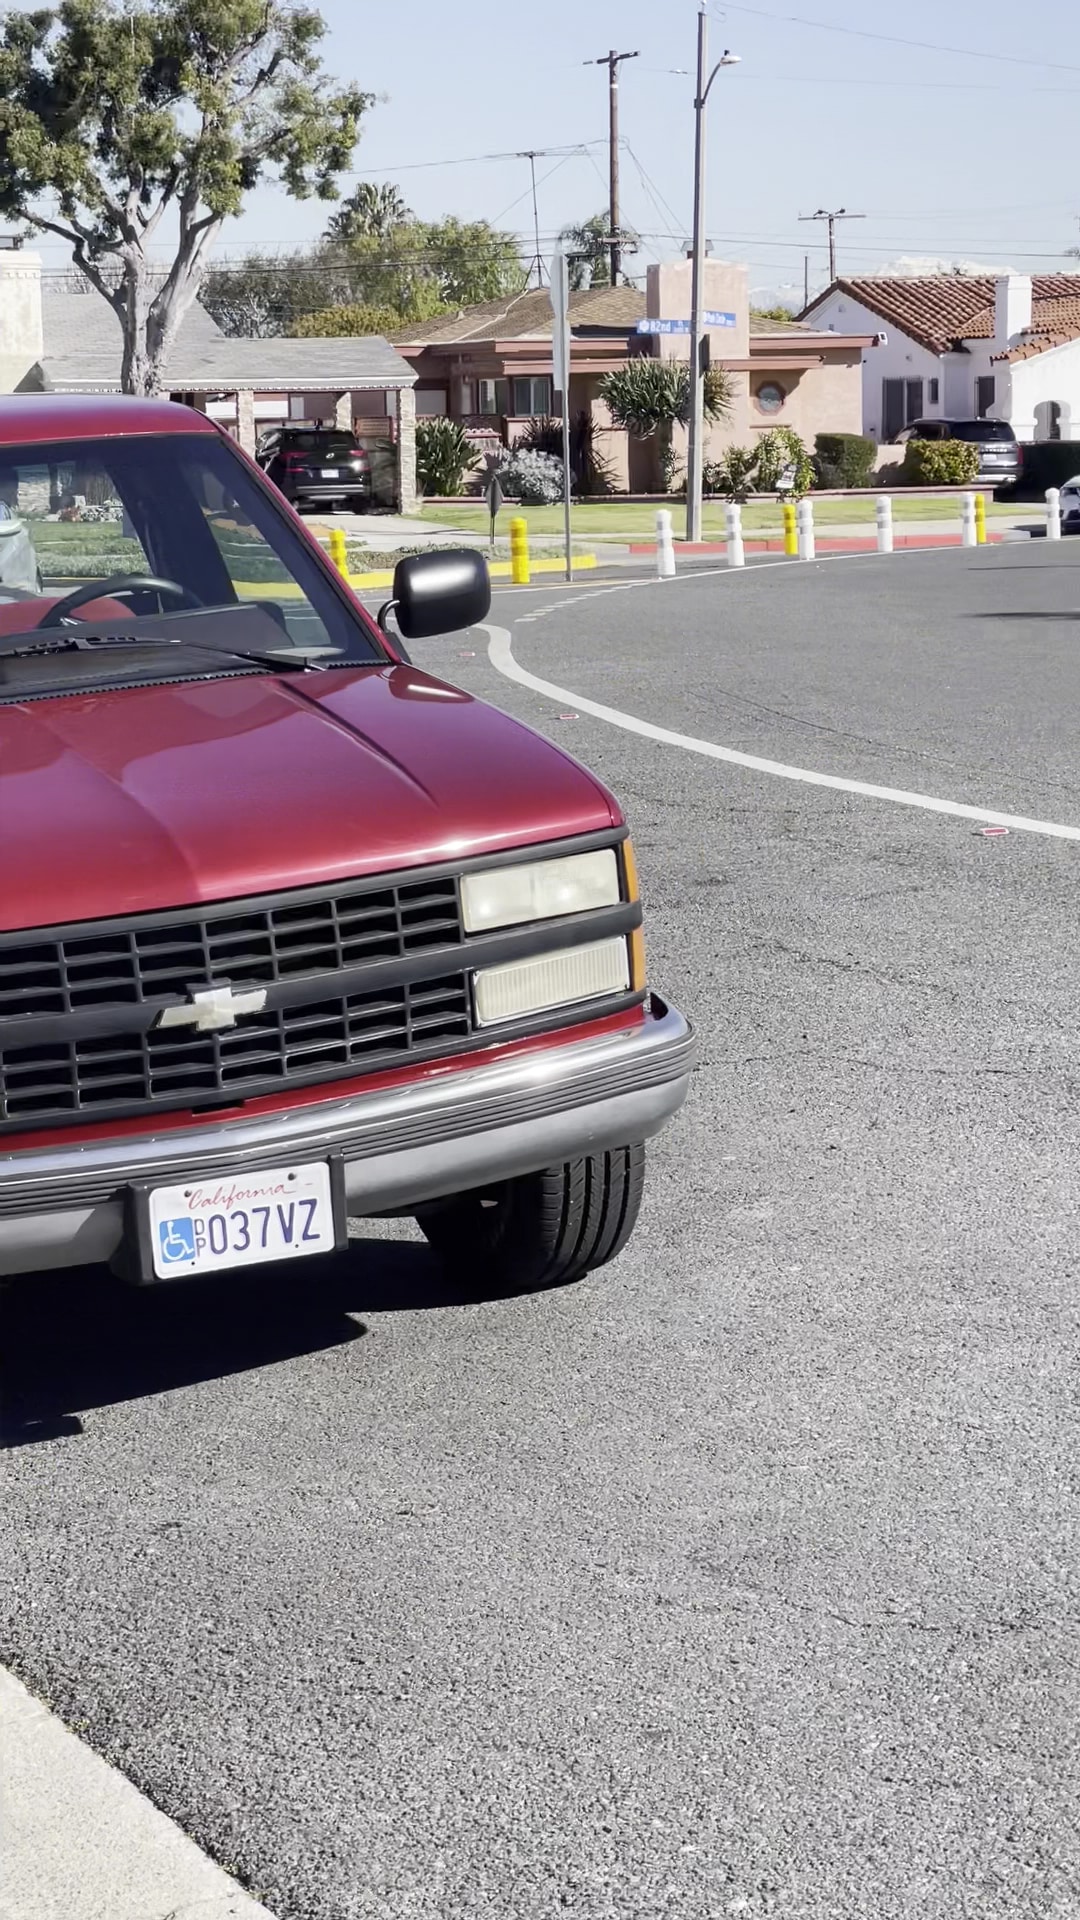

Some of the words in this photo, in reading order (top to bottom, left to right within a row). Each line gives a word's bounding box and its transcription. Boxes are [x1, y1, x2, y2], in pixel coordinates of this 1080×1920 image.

[650, 319, 671, 333] 82nd
[188, 1183, 296, 1211] California
[208, 1198, 320, 1255] 037VZ
